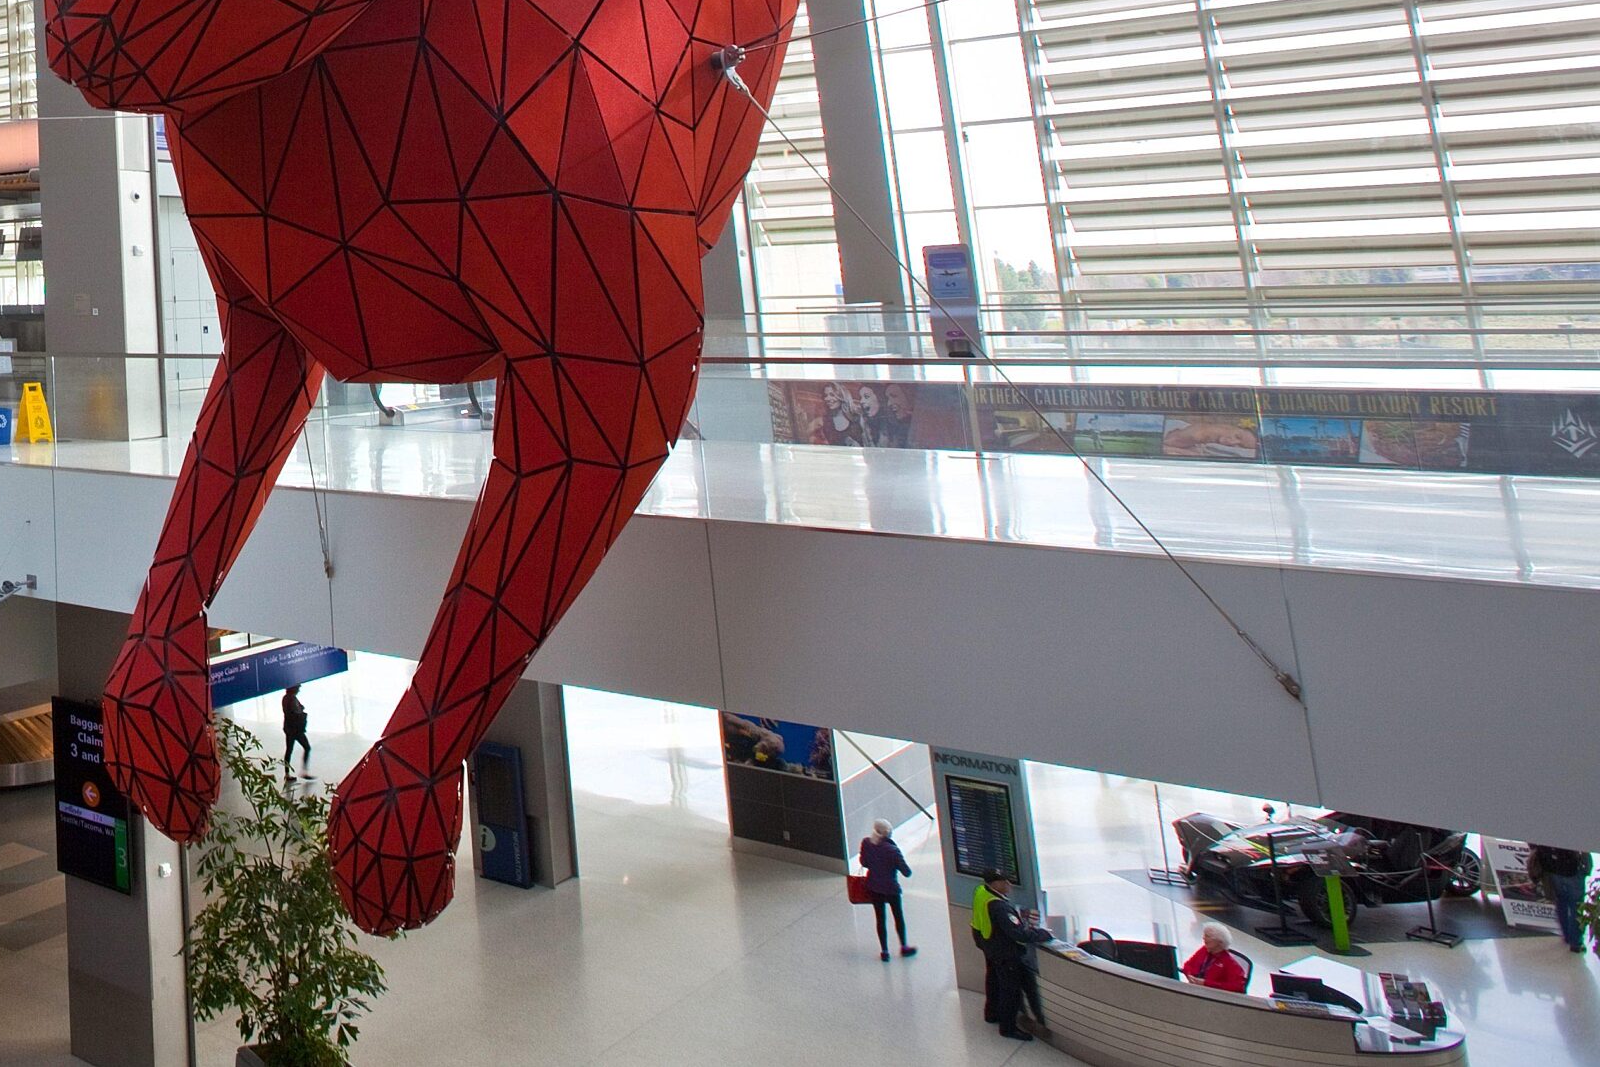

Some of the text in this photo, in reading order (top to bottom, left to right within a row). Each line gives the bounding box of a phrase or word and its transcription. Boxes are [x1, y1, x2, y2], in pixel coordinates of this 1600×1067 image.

[1034, 388, 1125, 407] CALIFORNIA'S
[1131, 390, 1191, 409] PREMIER
[1199, 391, 1226, 410] AAA
[1279, 393, 1351, 413] DIAMOND
[1359, 394, 1421, 415] LUXURY
[1430, 396, 1498, 416] RESORT
[70, 714, 103, 734] Baggag
[77, 731, 103, 747] Claim
[70, 742, 100, 764] 3 and
[934, 752, 1017, 775] INFORMATION
[118, 847, 127, 868] 3
